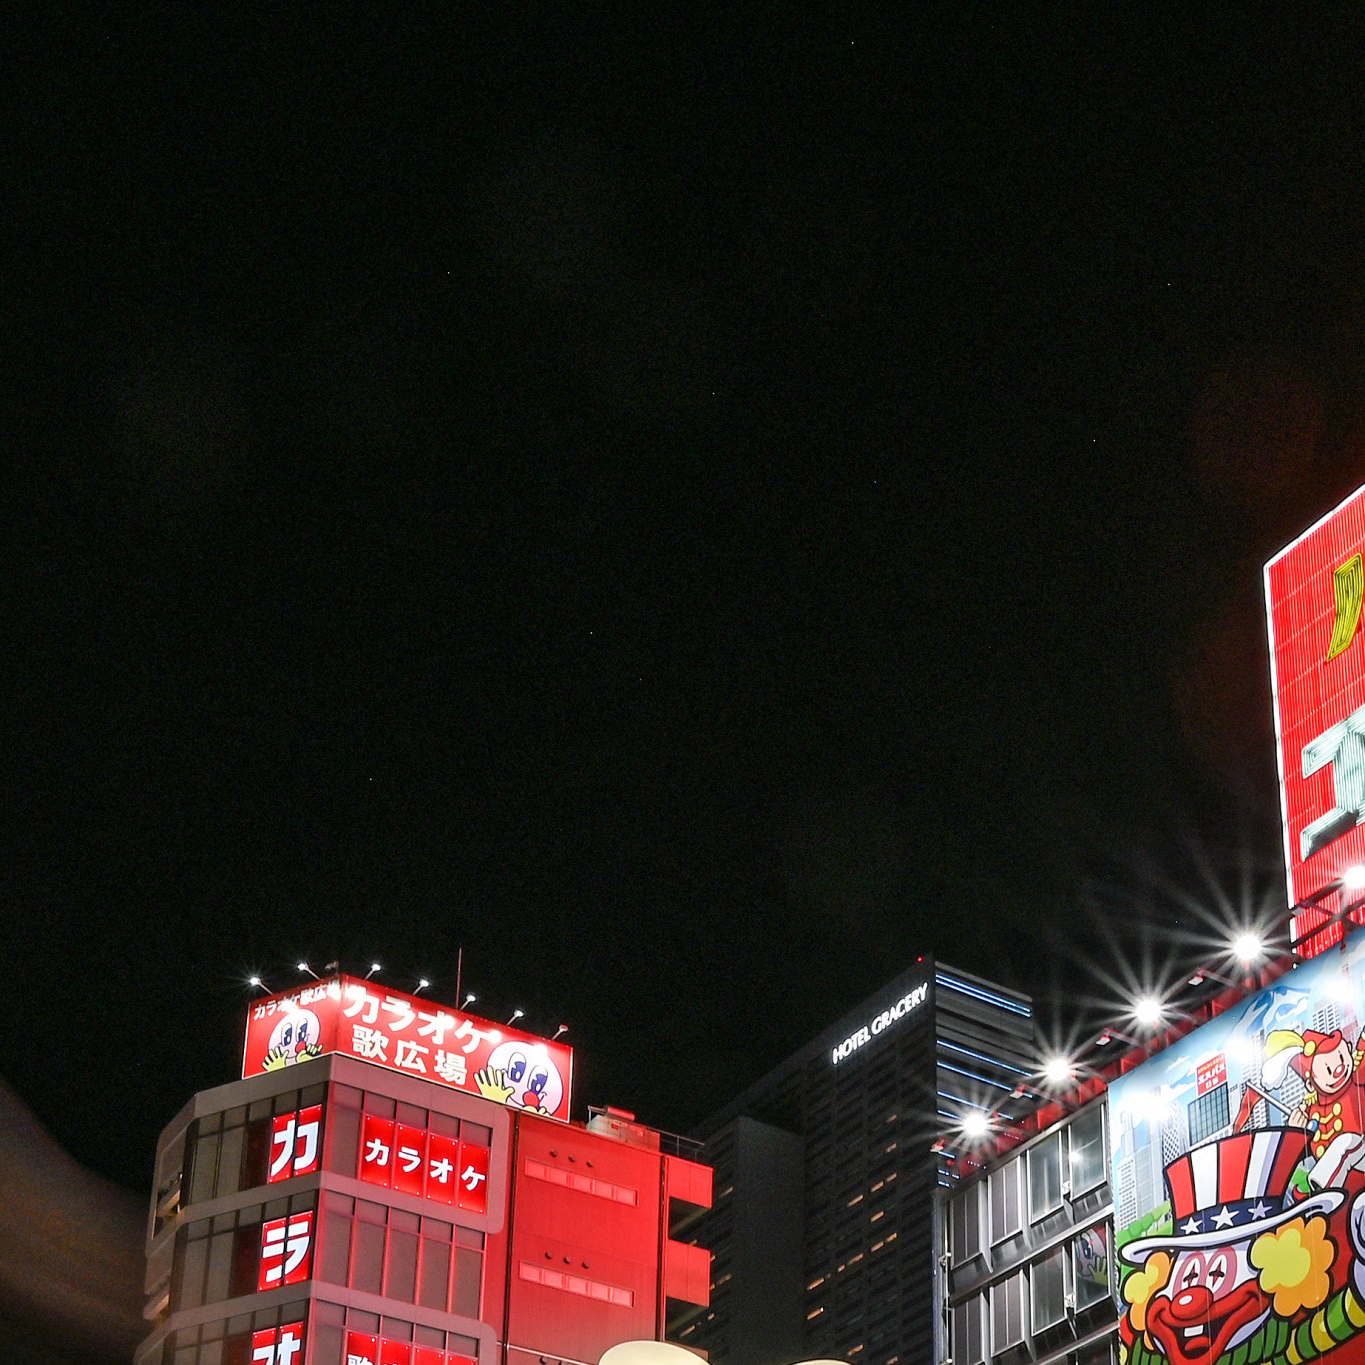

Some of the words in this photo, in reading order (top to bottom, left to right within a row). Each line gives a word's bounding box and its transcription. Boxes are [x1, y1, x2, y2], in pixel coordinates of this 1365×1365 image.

[344, 986, 495, 1053] カラオケ
[832, 1026, 872, 1065] HOTEL
[871, 981, 929, 1036] GRACERY
[351, 1024, 468, 1085] 歌広場
[364, 1138, 487, 1192] カラオケ
